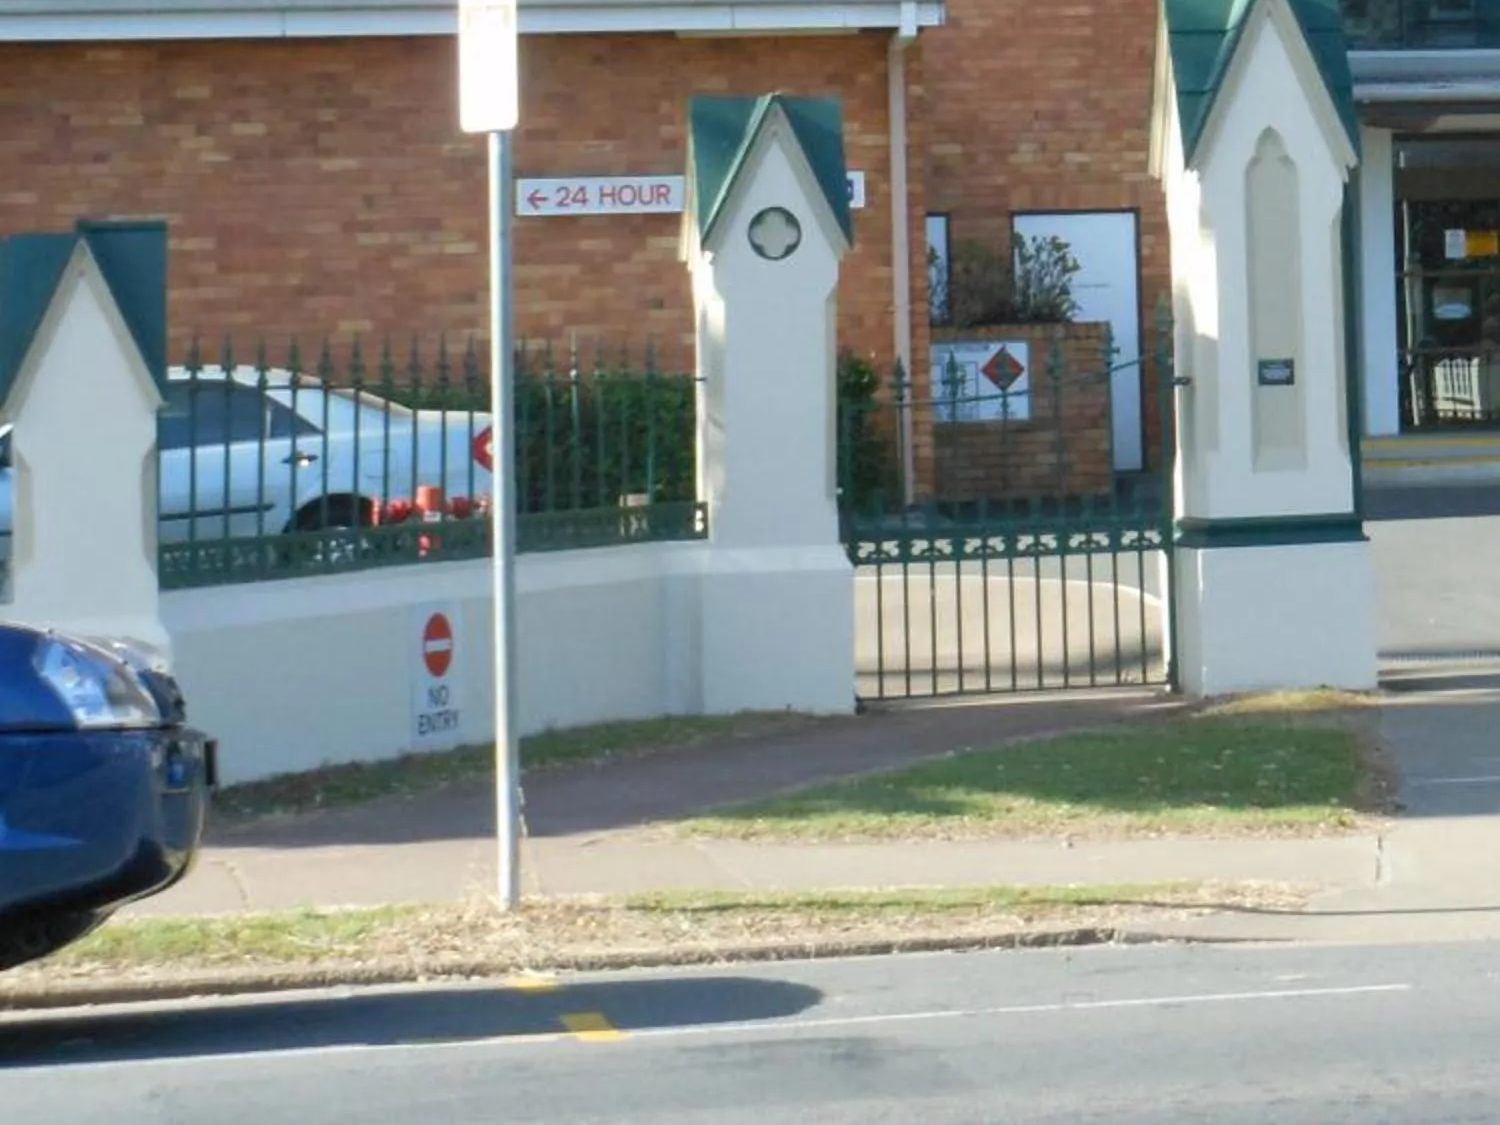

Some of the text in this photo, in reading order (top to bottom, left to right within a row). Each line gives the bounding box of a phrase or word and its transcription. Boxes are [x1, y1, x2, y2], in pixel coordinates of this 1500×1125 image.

[555, 184, 671, 207] 24 HOUR
[427, 685, 449, 708] NO
[417, 709, 459, 736] ENTRY
